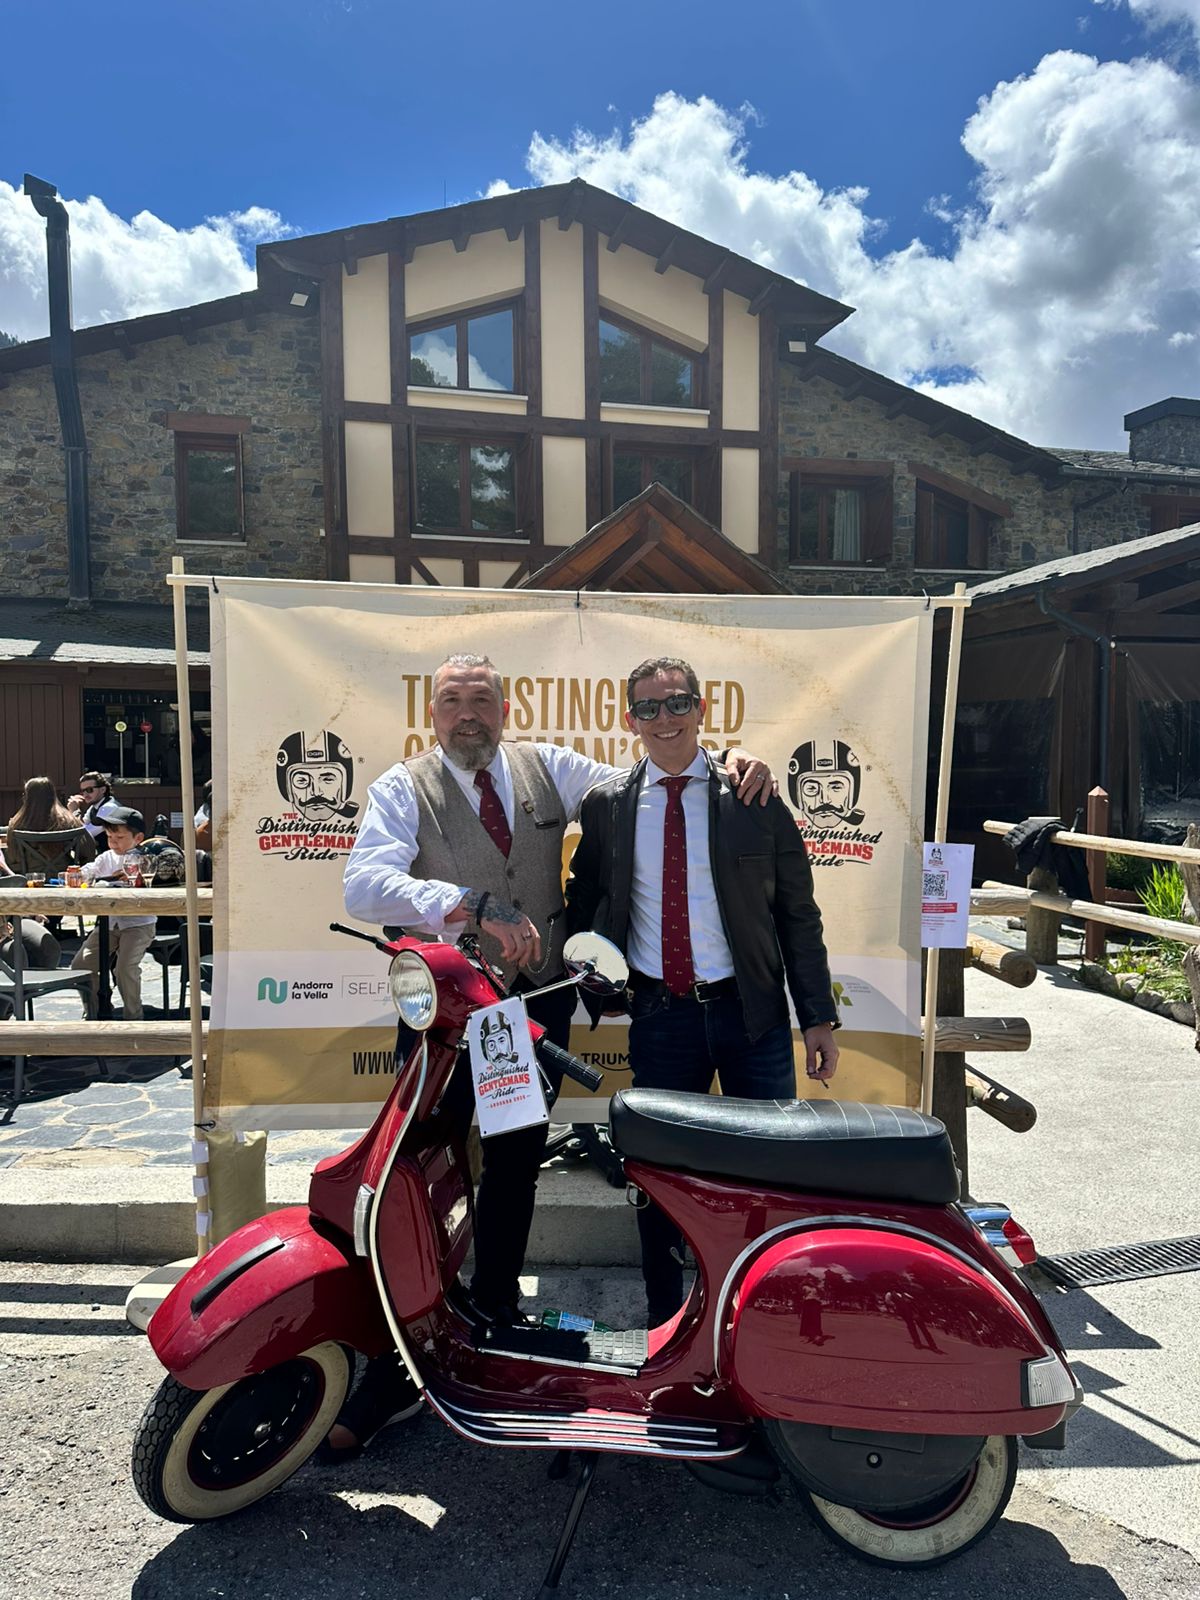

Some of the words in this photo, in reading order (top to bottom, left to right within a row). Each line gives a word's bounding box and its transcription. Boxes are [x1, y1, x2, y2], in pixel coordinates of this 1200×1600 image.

[502, 677, 744, 734] ISTINGED
[255, 816, 360, 838] Distinguish
[259, 834, 356, 850] GENTLEMAN
[801, 827, 883, 844] tinguished
[284, 847, 340, 860] Ride
[292, 981, 334, 990] Andorra
[348, 982, 390, 995] SELFI
[291, 991, 301, 1000] la
[303, 991, 329, 1000] Vella
[353, 1051, 396, 1074] WWW
[581, 1053, 632, 1065] TRIUM
[478, 1062, 529, 1084] Distinguished
[491, 1086, 516, 1099] Ride
